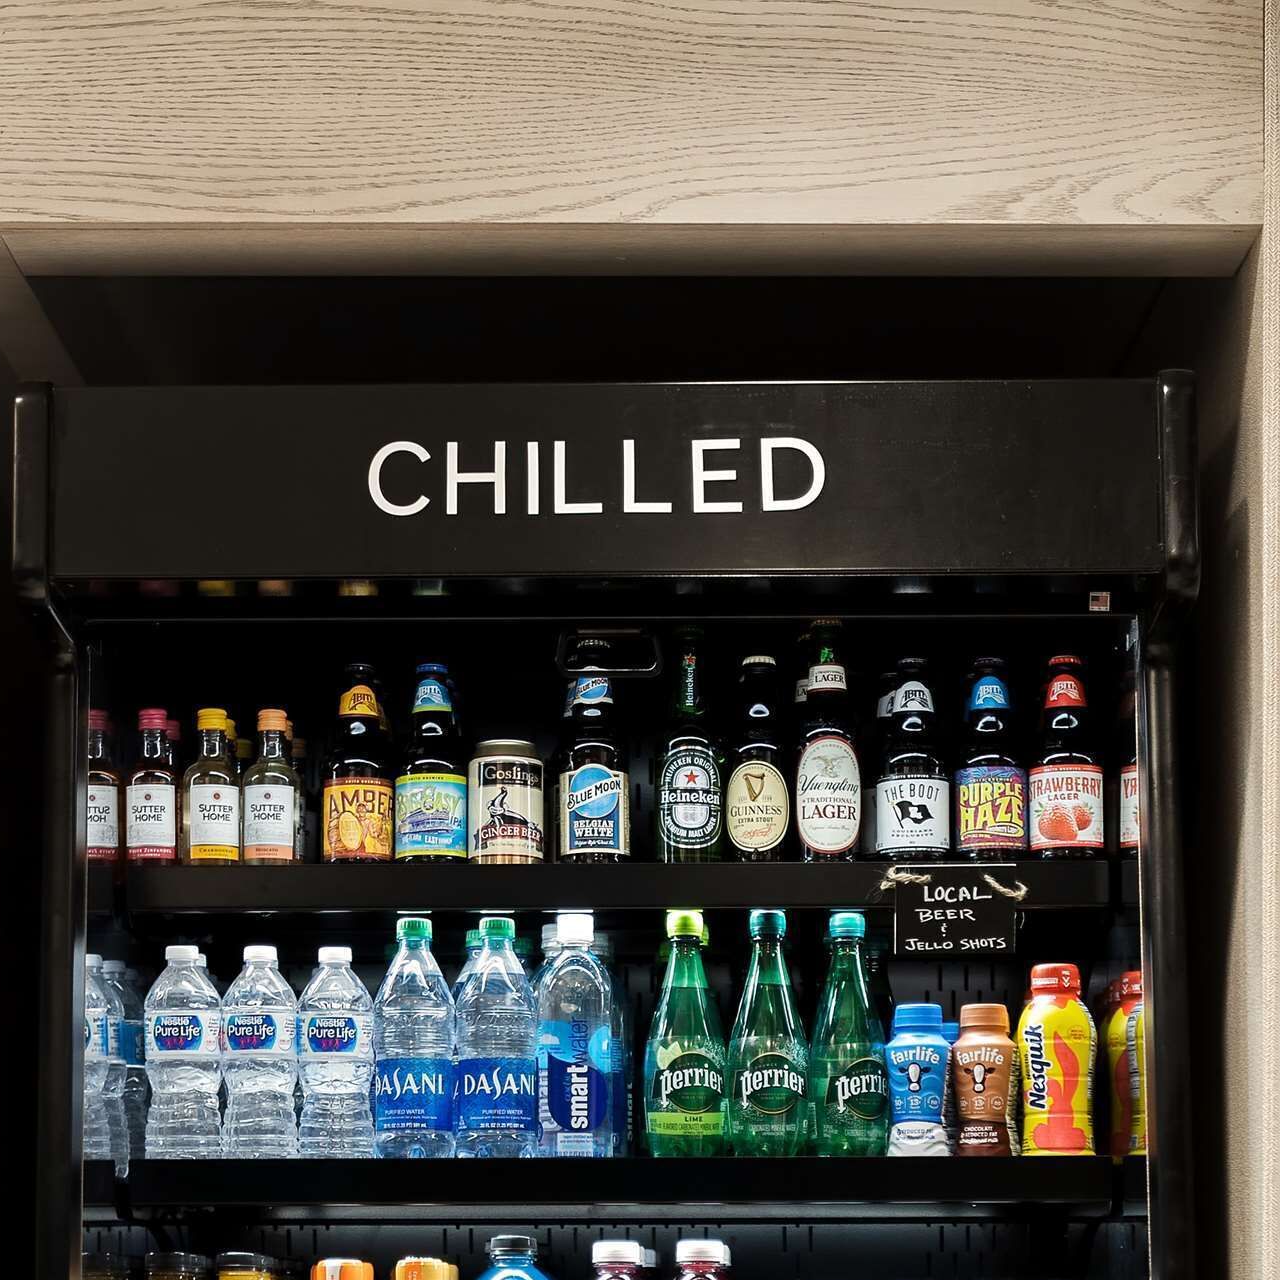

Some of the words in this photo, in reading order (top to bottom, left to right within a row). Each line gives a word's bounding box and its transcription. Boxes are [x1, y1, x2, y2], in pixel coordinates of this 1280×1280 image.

[368, 437, 826, 516] CHILLED
[815, 674, 844, 683] LAGER
[664, 757, 692, 783] HEINEKEN
[694, 757, 718, 783] ORIGINAL
[799, 774, 859, 797] Yuengling
[884, 784, 907, 803] THE
[908, 783, 940, 803] BOOT
[1029, 777, 1102, 800] STRAWBERRY
[568, 790, 593, 809] BLUE
[595, 779, 622, 796] MOON
[661, 791, 720, 805] Heineken
[959, 782, 1023, 807] PURPLE
[1048, 793, 1080, 802] LAGER
[131, 806, 166, 814] SUTTER
[198, 804, 233, 814] SUTTER
[250, 804, 285, 813] SUTTER
[330, 789, 394, 819] AMBER
[730, 805, 782, 818] GUINNESS
[135, 814, 162, 822] HOME
[203, 813, 231, 822] HOME
[254, 813, 281, 821] HOME
[801, 805, 857, 821] LAGER
[959, 797, 1024, 838] HAZE
[573, 820, 614, 828] BELGIAN
[482, 827, 521, 839] GINGER
[521, 827, 542, 841] BEER
[574, 828, 614, 837] WHITE
[923, 885, 993, 903] LOCAL
[914, 909, 976, 923] BEER
[905, 938, 954, 951] JELLO
[960, 937, 1007, 951] SHOTS
[155, 1026, 180, 1037] Pure
[180, 1025, 201, 1040] Life
[228, 1025, 253, 1036] Pure
[253, 1025, 275, 1040] Life
[309, 1027, 334, 1037] Pure
[335, 1026, 356, 1042] Life
[1026, 1023, 1053, 1110] Nesquik
[376, 1067, 444, 1100] DASANI
[464, 1067, 535, 1100] DASANI
